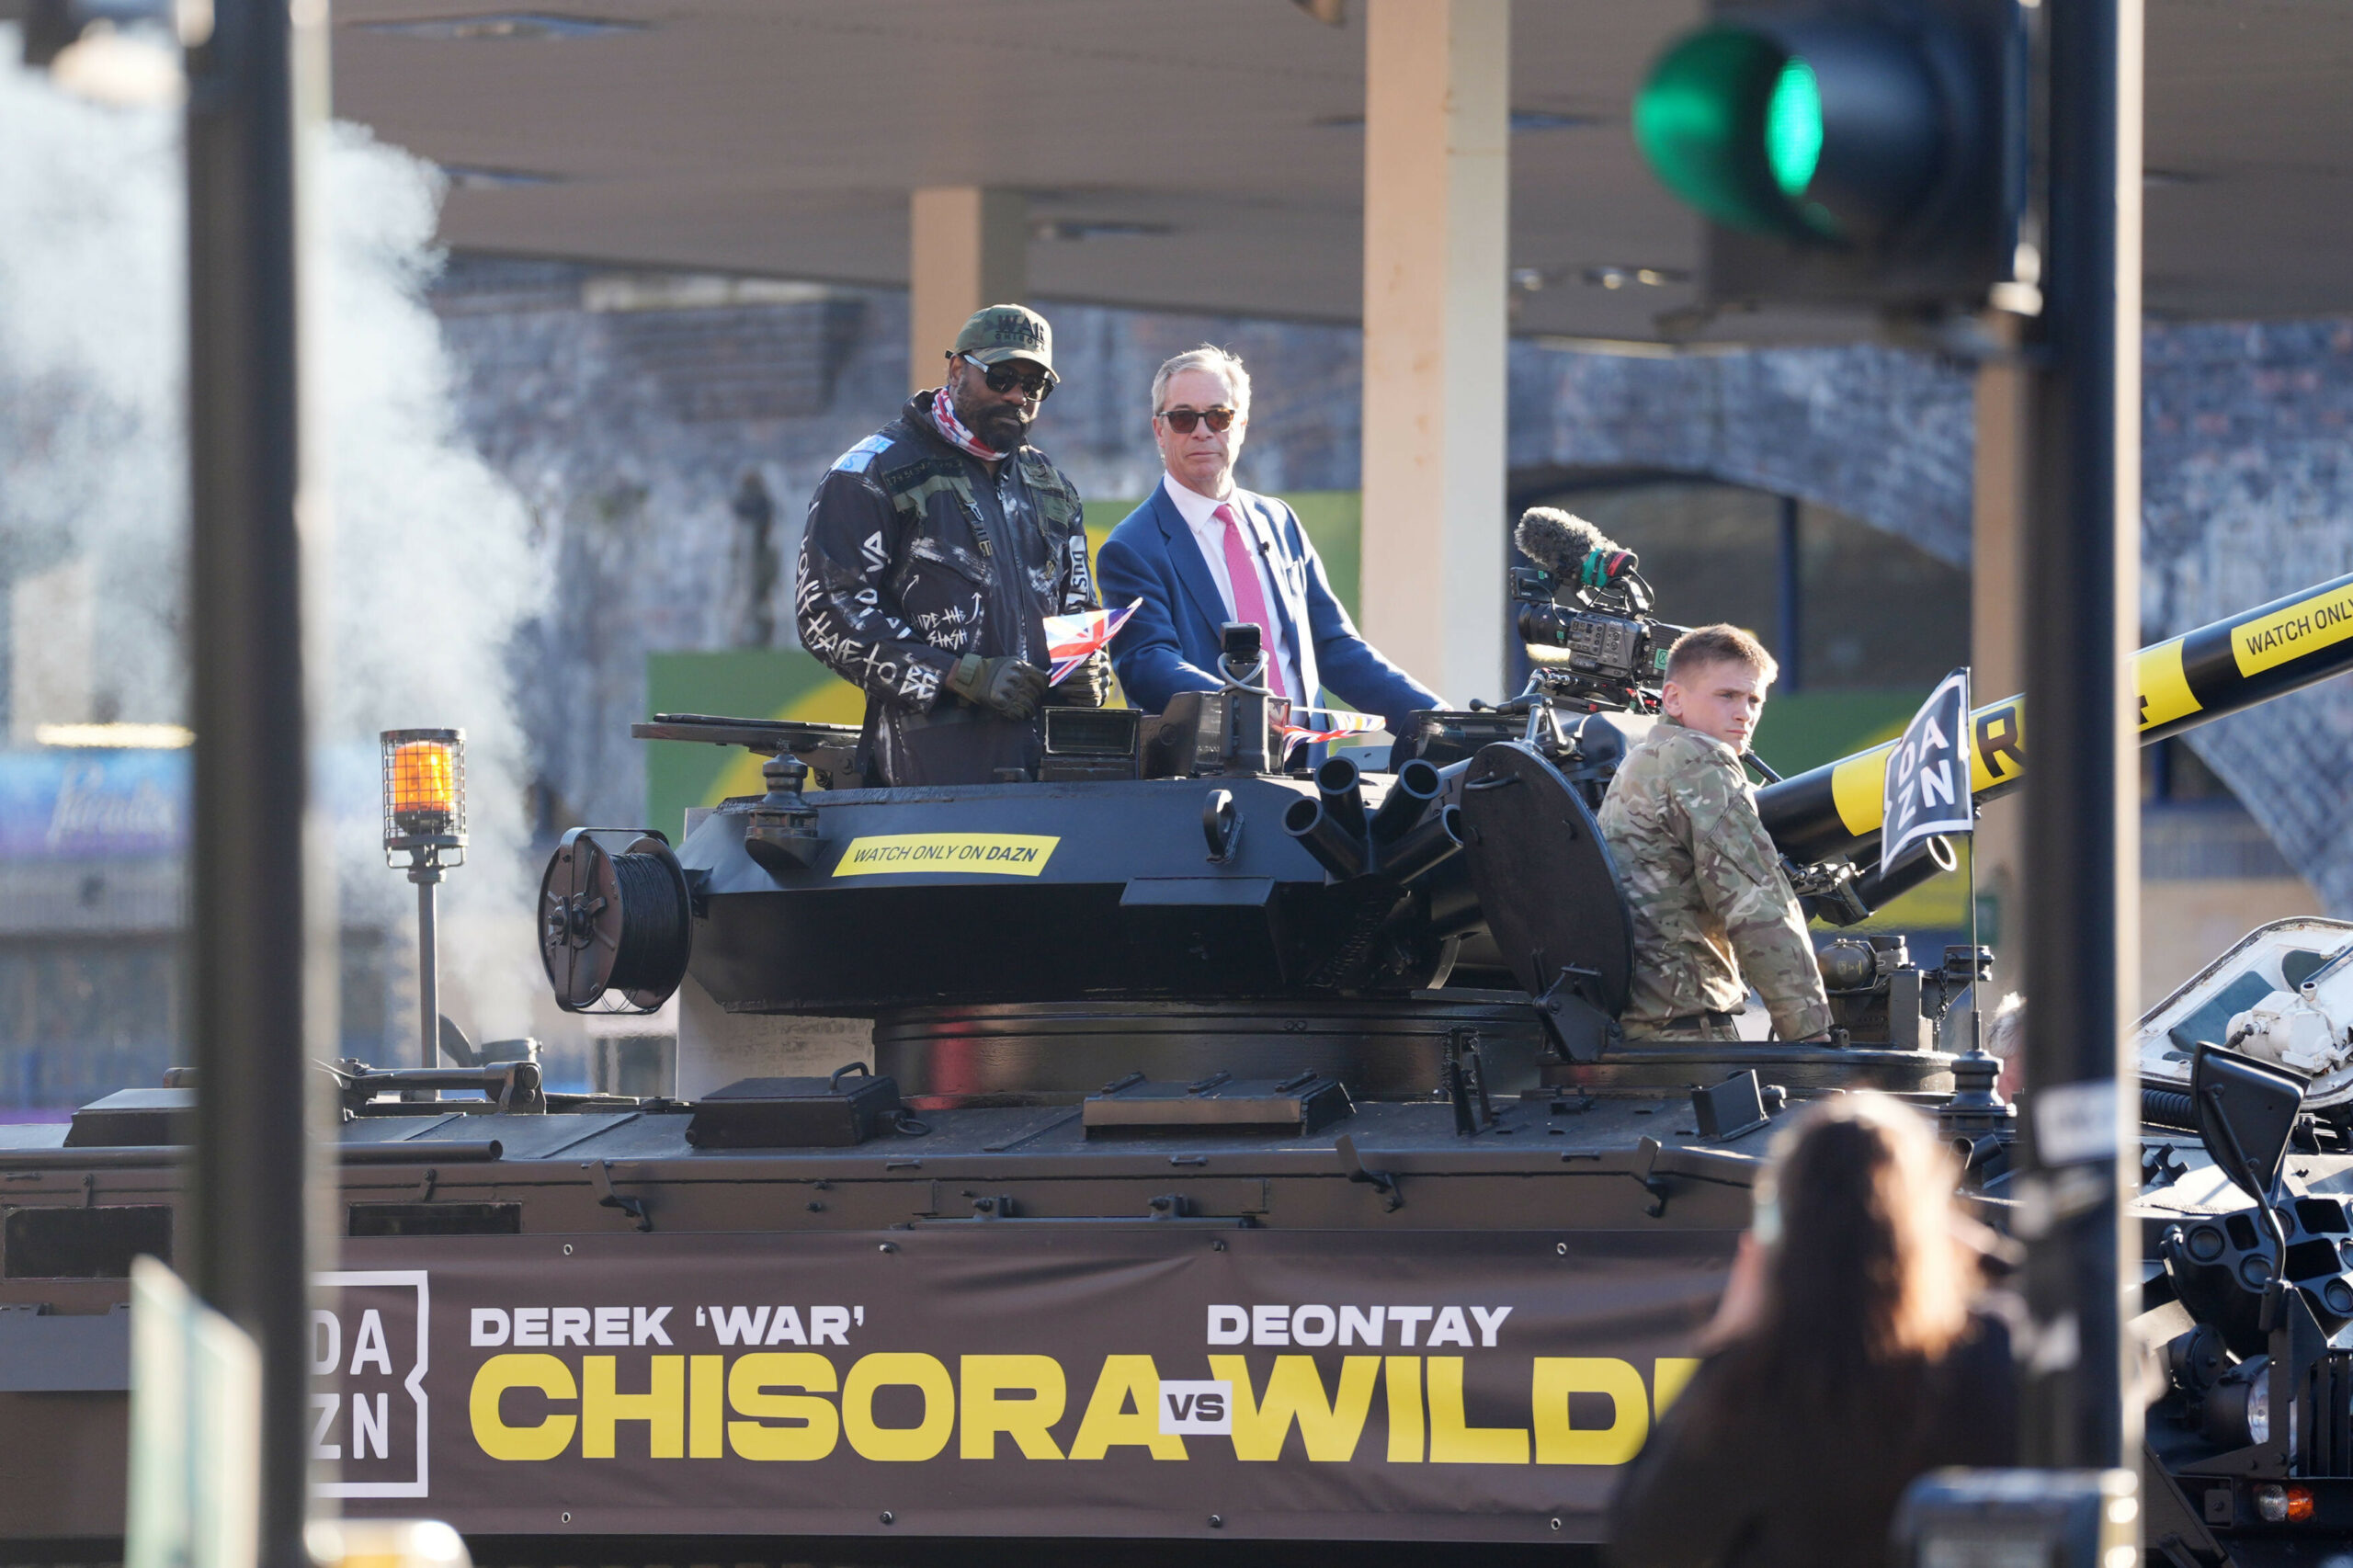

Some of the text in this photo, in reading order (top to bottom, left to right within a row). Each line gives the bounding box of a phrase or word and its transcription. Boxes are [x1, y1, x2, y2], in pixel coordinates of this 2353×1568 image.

[996, 313, 1045, 341] WAR
[926, 628, 968, 651] STASH
[2245, 615, 2312, 656] WATCH
[898, 663, 939, 700] BE
[853, 845, 1039, 863] WATCH ONLY ON DAZN
[470, 1305, 675, 1347] DEREK
[1207, 1303, 1514, 1348] DEONTAY
[469, 1351, 1190, 1462] CHISORA
[1206, 1353, 1700, 1466] WILD
